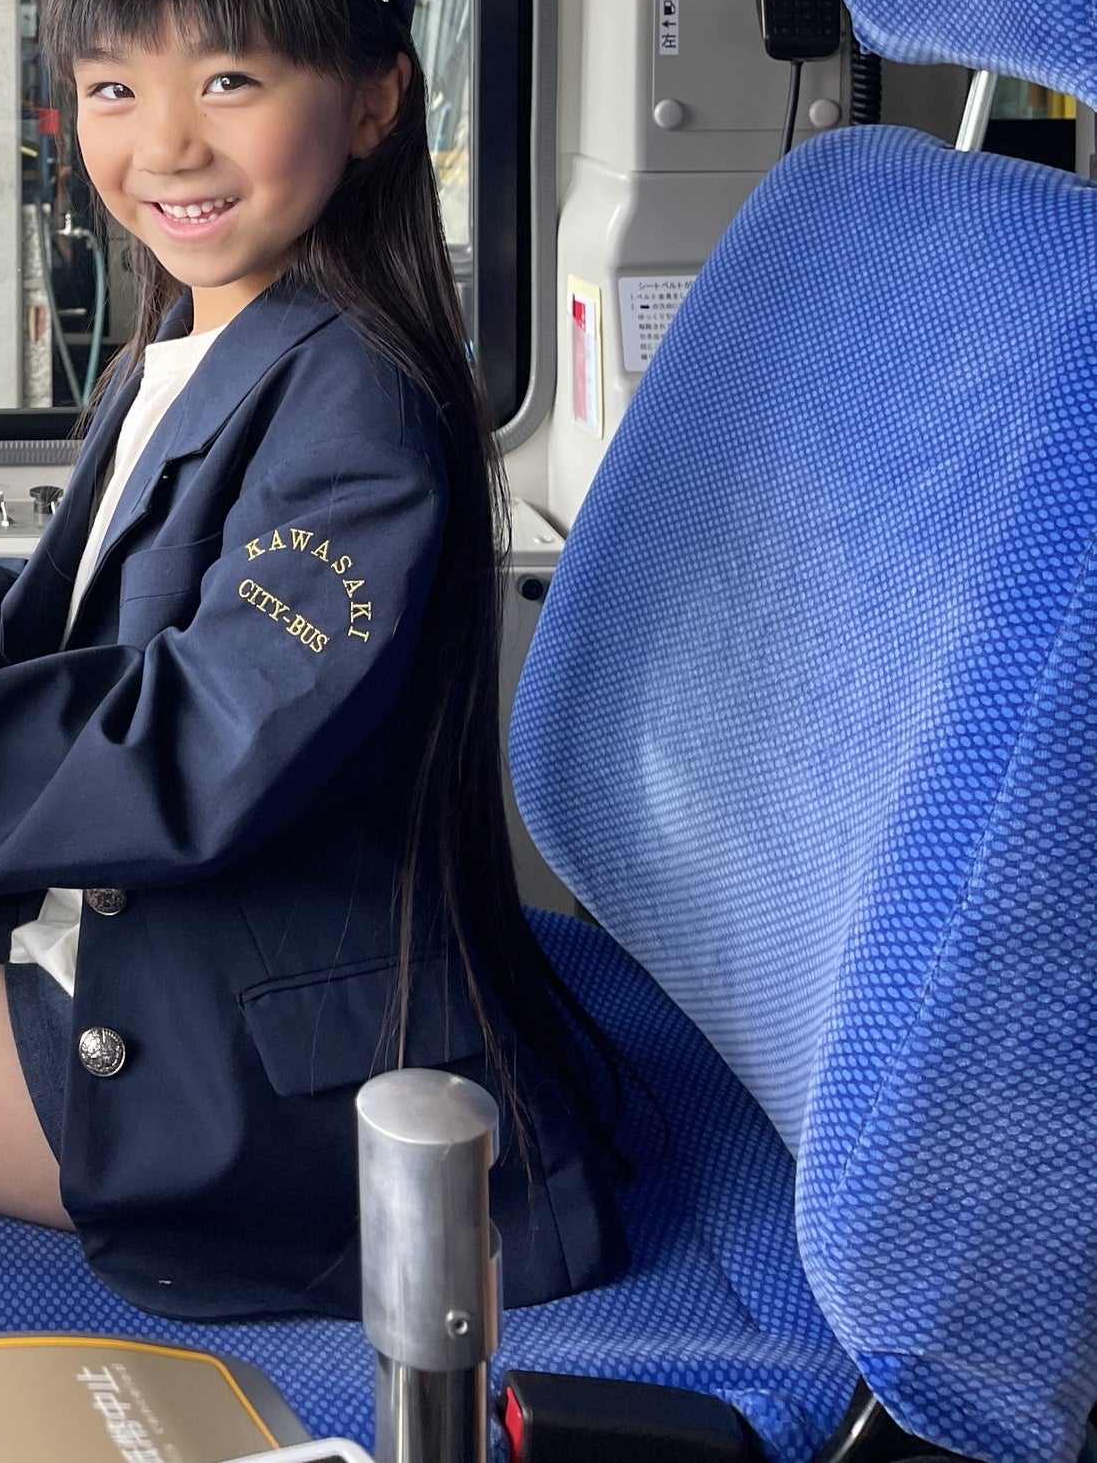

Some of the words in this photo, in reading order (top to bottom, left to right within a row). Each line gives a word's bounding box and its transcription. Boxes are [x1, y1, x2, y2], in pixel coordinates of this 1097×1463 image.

[661, 32, 677, 48] 左
[238, 578, 331, 653] CITY-BUS
[244, 527, 372, 643] KAWASAKI
